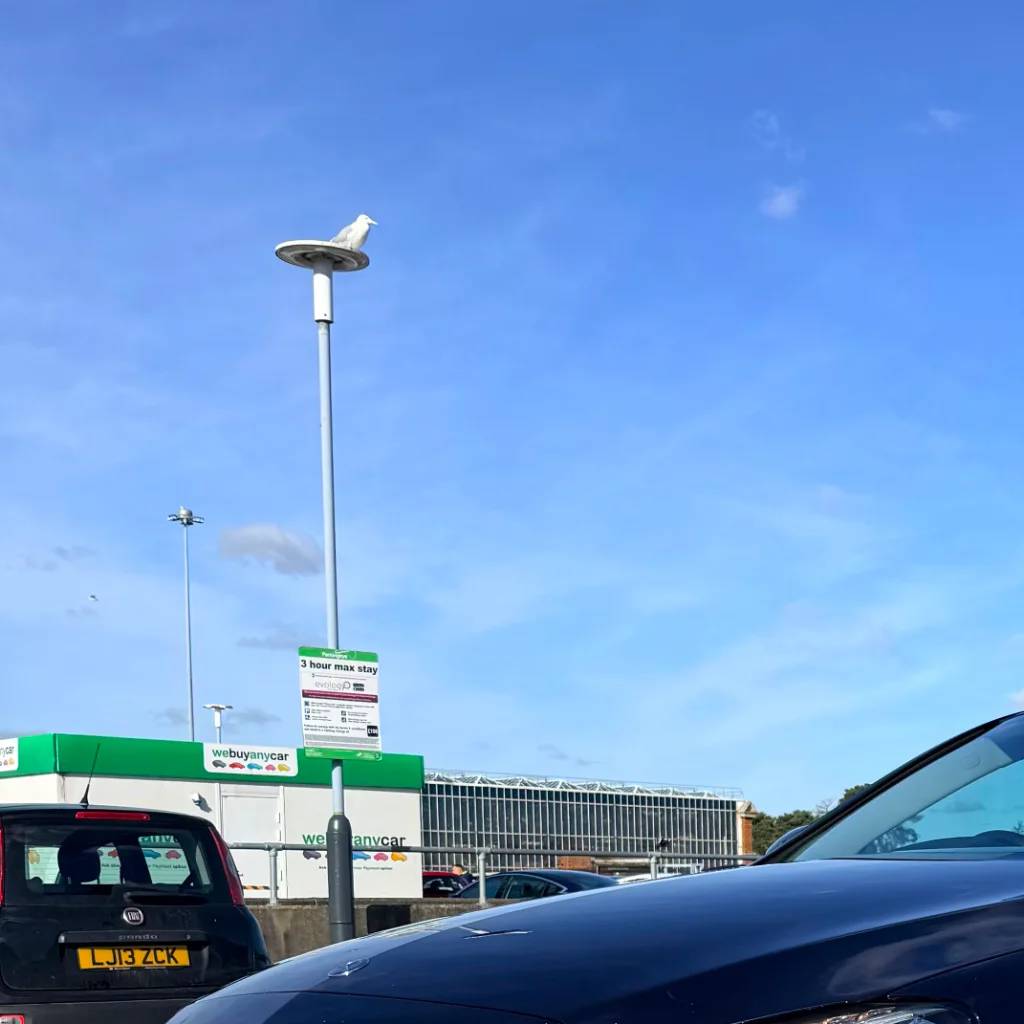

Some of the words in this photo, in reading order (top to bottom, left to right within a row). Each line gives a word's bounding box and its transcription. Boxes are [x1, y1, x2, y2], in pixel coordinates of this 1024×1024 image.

[301, 660, 307, 668] 3
[310, 660, 332, 670] hour
[334, 663, 355, 672] max
[357, 665, 378, 675] stay
[212, 748, 289, 762] webuyanycar
[91, 948, 136, 966] LJ13
[142, 947, 179, 965] ZCK
